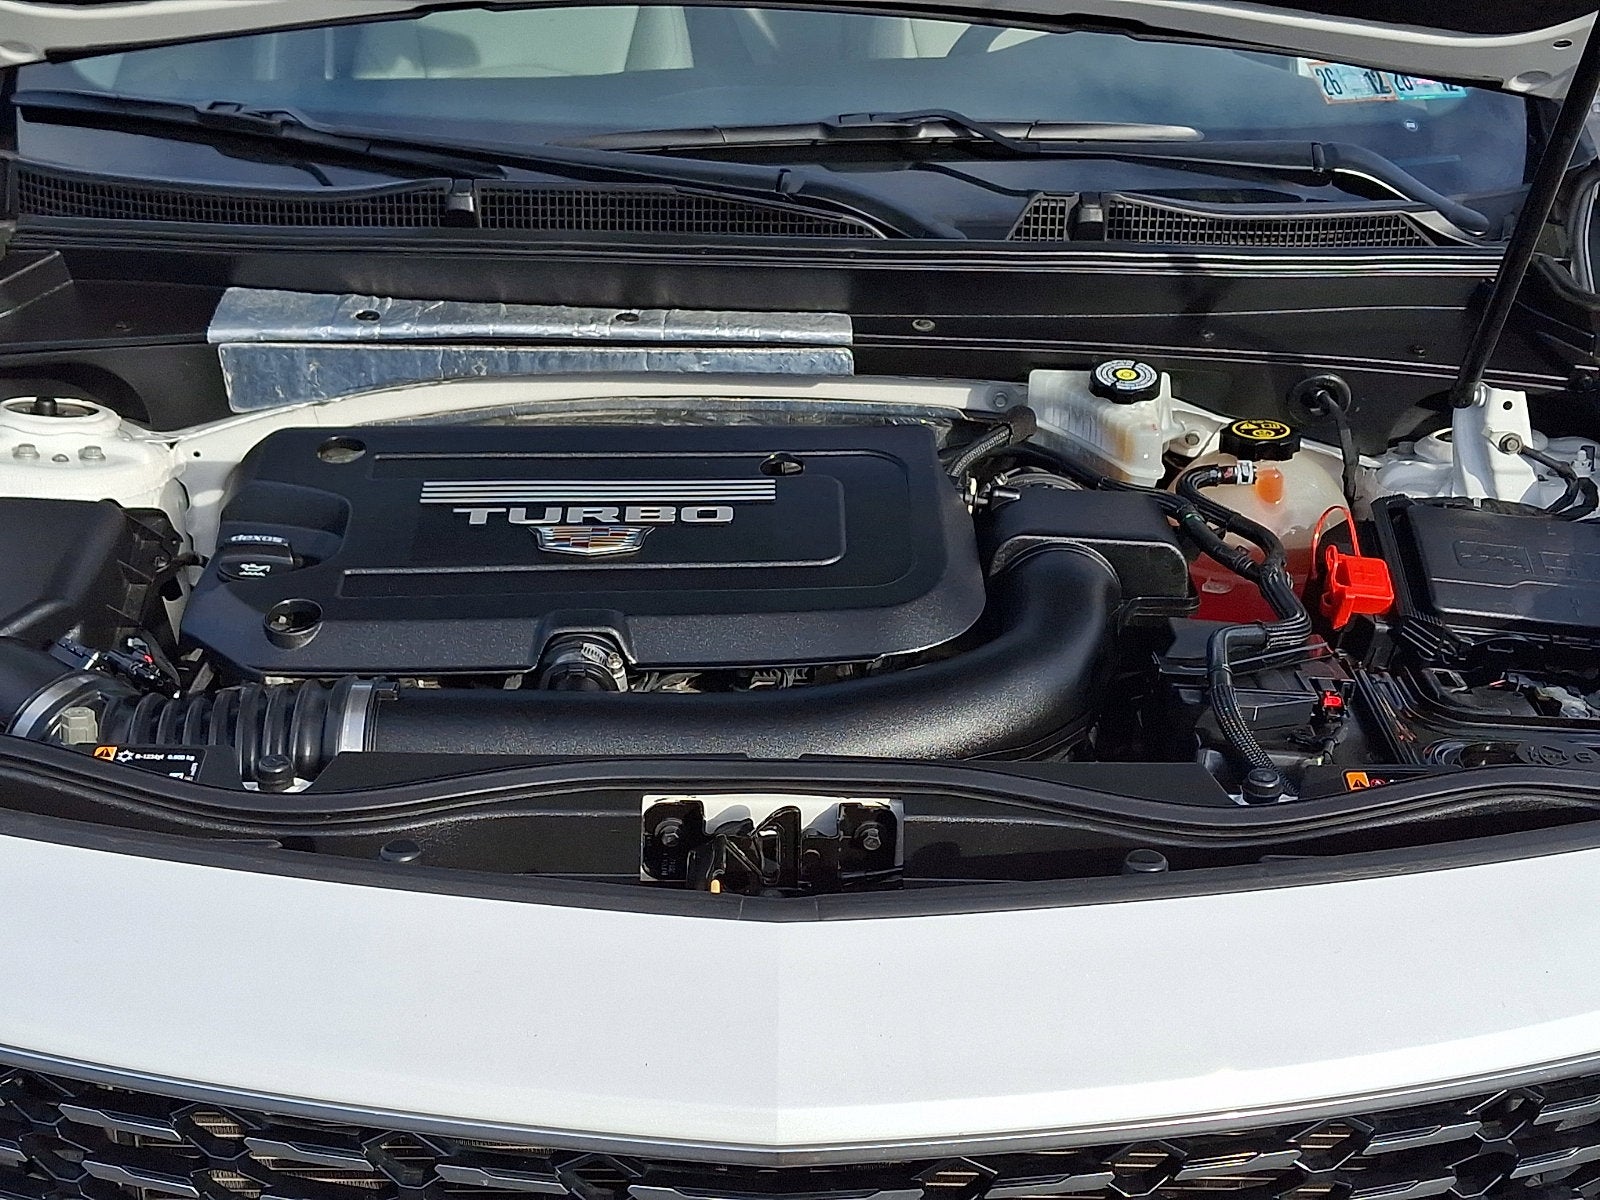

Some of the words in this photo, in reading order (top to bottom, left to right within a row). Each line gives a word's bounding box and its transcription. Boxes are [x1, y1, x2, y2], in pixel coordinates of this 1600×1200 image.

[1315, 67, 1343, 96] 26
[1363, 70, 1393, 95] 12
[453, 506, 734, 525] TURBO
